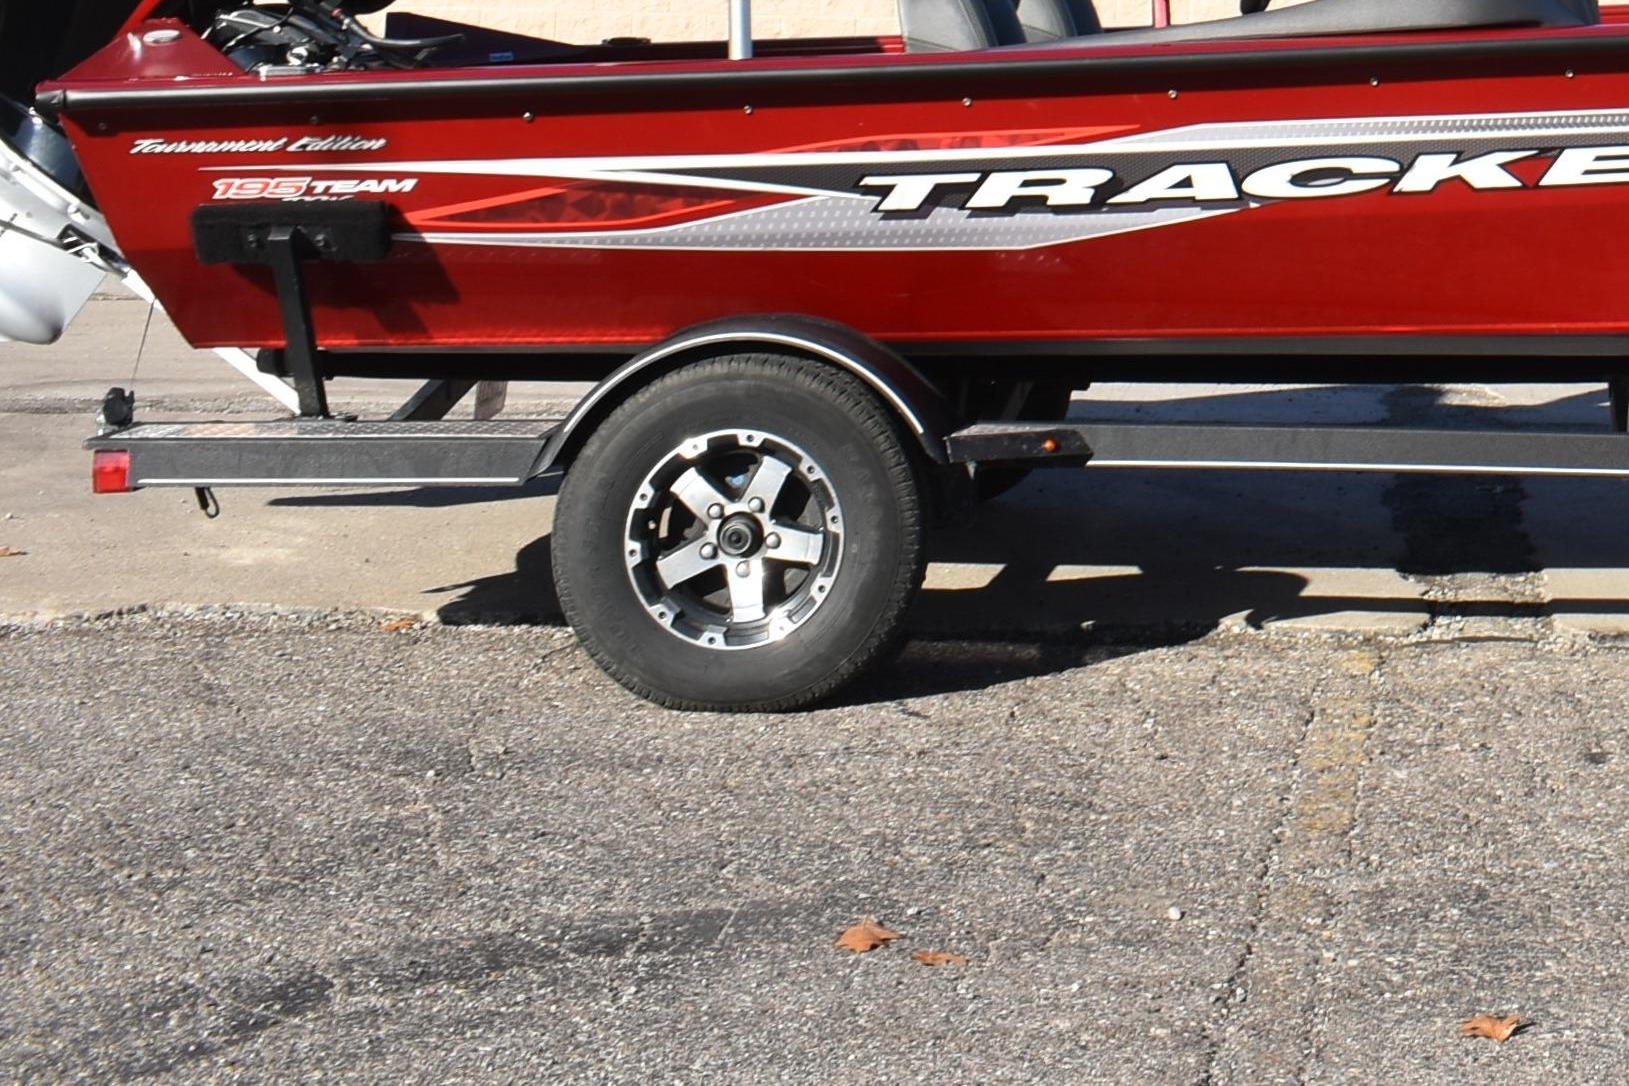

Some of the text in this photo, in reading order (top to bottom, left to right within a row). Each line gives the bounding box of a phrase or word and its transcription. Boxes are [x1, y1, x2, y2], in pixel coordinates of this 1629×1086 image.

[129, 135, 387, 154] Tournament Edition
[211, 176, 313, 200] 195
[310, 178, 419, 195] TEAM
